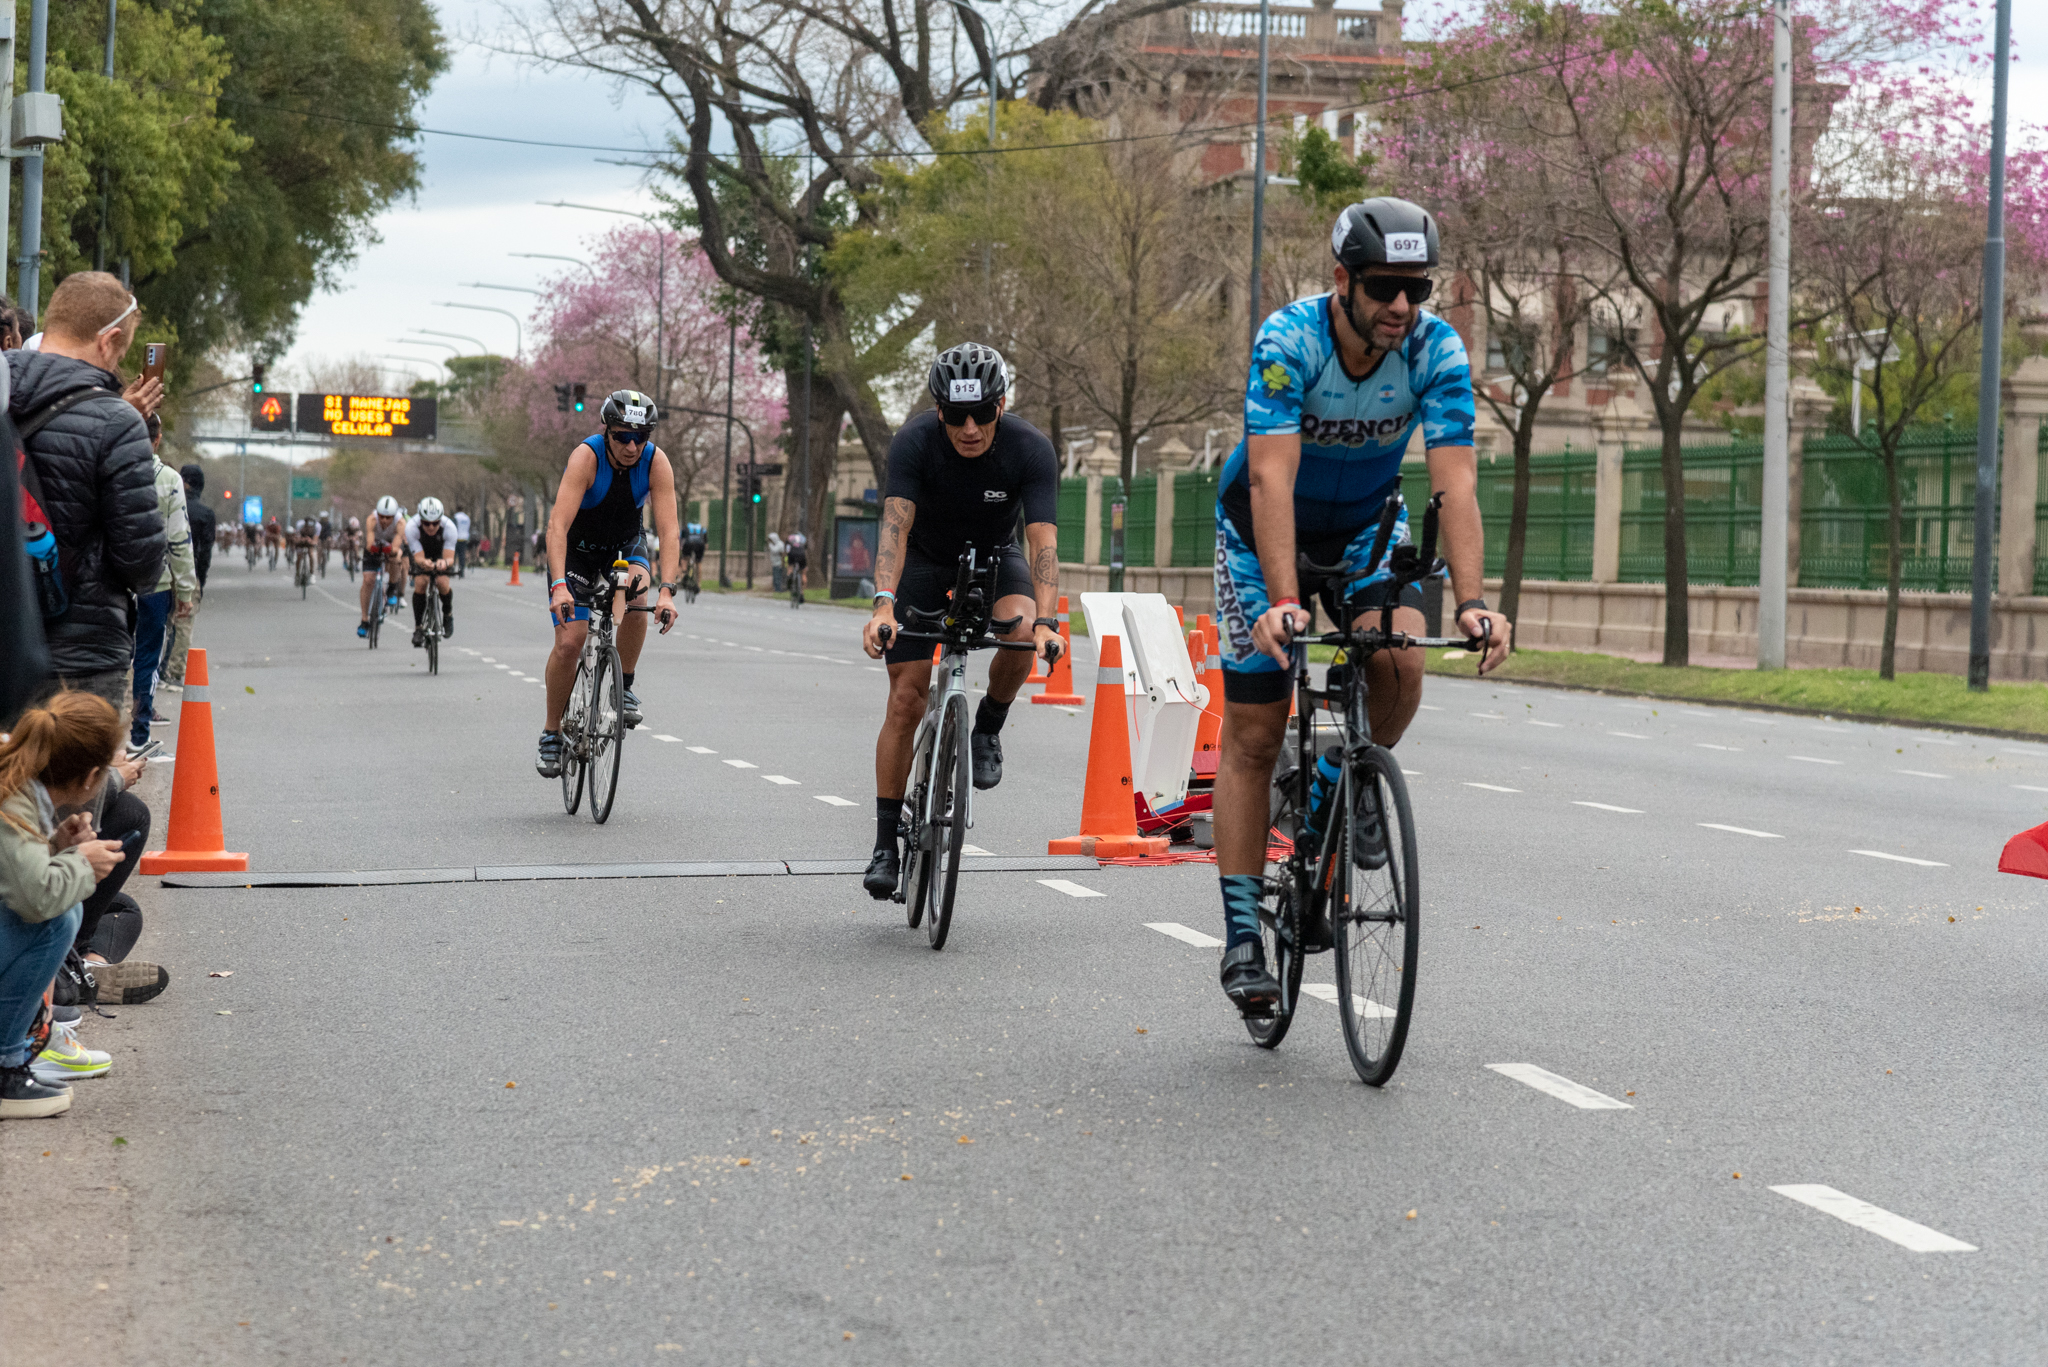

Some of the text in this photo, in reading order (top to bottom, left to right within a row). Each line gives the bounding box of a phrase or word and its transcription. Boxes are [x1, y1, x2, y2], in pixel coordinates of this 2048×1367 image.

[1394, 239, 1419, 251] 697
[955, 384, 975, 393] 915
[324, 395, 411, 412] SI MANEJAS
[323, 408, 410, 425] NO USES EL
[628, 409, 643, 417] 780
[331, 421, 393, 436] CELULAR
[1301, 412, 1414, 439] OTENCI
